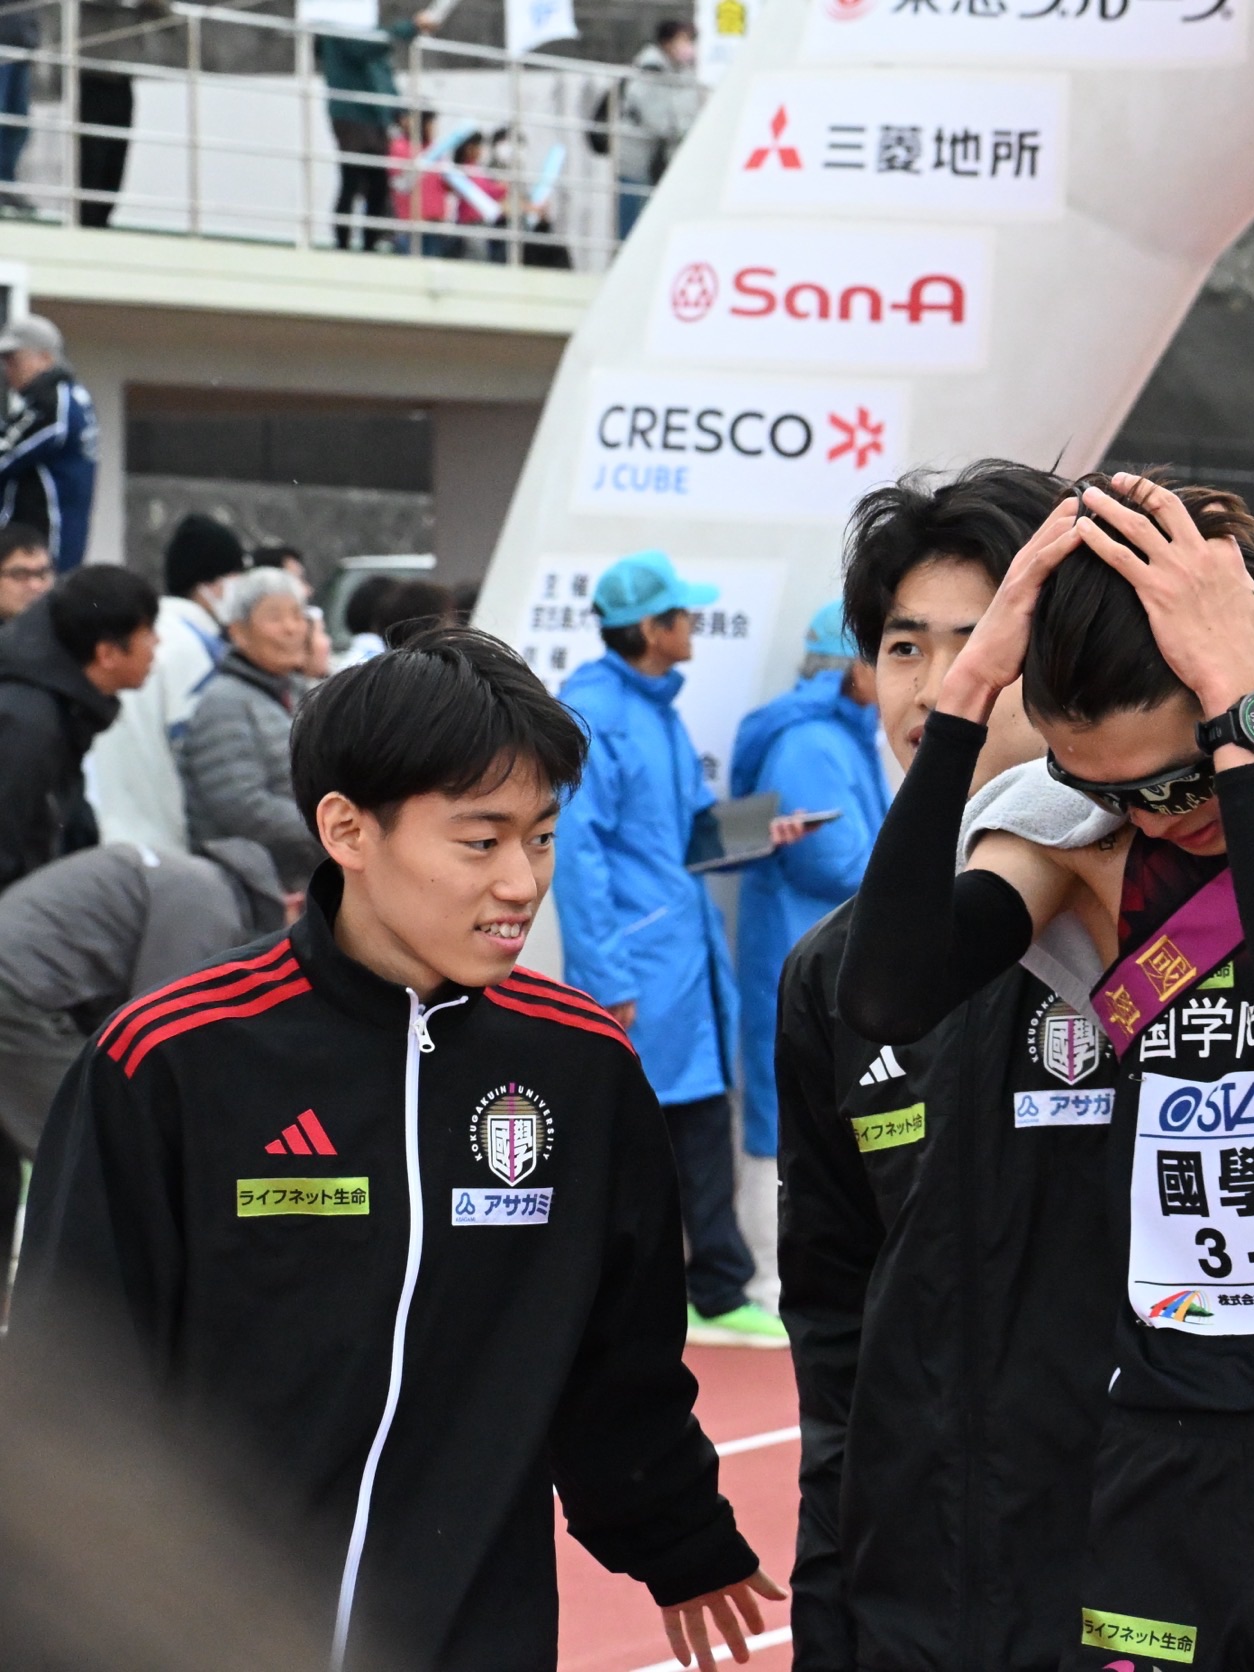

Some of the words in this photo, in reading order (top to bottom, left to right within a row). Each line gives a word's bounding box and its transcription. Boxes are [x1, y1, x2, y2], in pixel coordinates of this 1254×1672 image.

[822, 124, 1040, 178] 三菱地所
[729, 266, 966, 325] San-A
[597, 404, 814, 459] CRESCO
[611, 463, 689, 494] CUBE
[517, 1085, 555, 1161] UNIVERSITY
[239, 1187, 367, 1206] ライフネット生命
[483, 1192, 551, 1217] アサガミ
[1084, 1619, 1194, 1653] ライフネット生命
